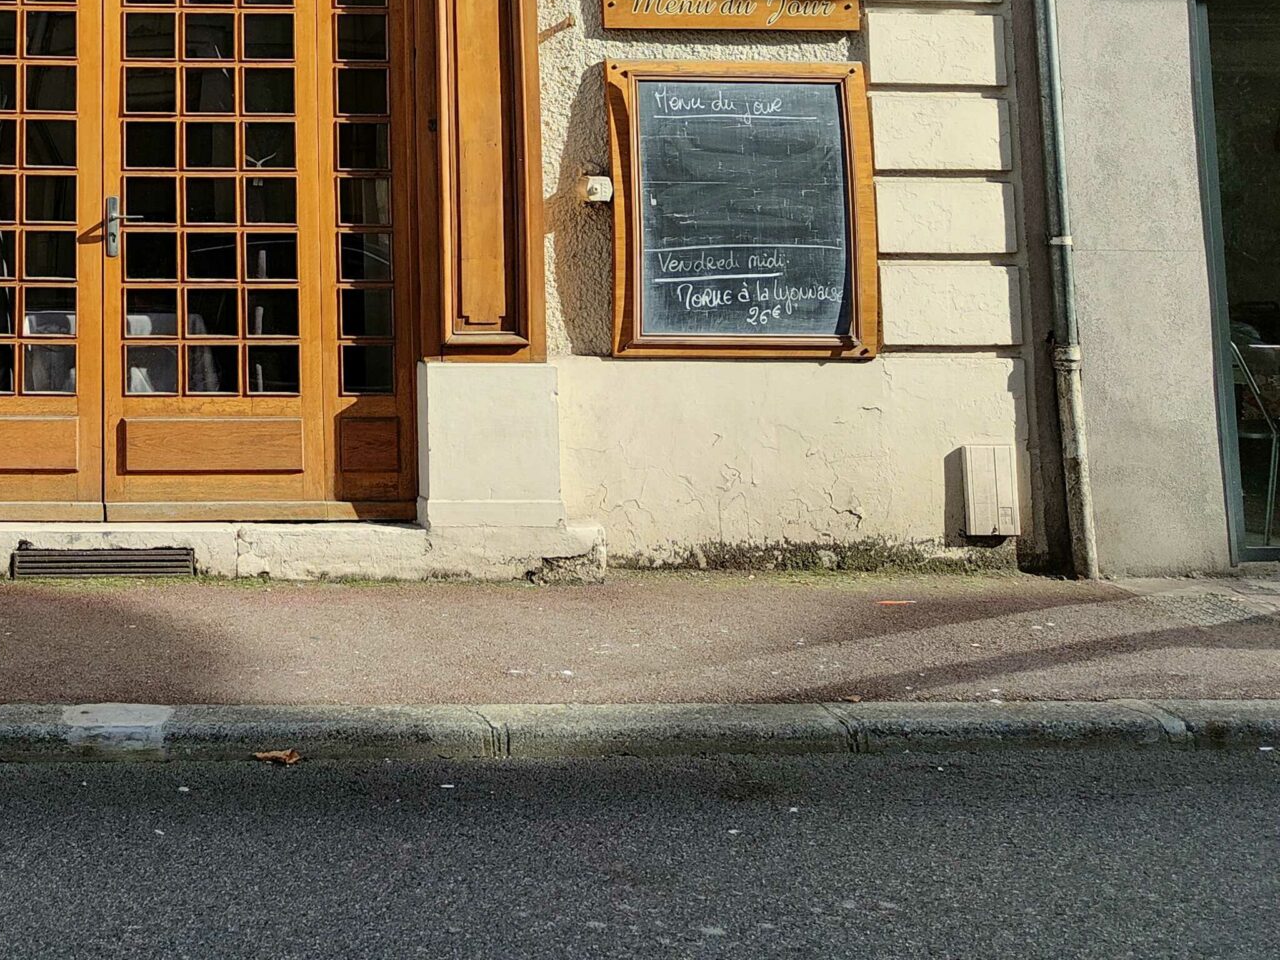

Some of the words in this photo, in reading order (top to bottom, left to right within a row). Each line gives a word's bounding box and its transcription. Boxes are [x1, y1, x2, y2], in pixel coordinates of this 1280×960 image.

[654, 85, 705, 113] Menu
[711, 91, 737, 111] du
[737, 281, 751, 303] à
[756, 280, 769, 302] la
